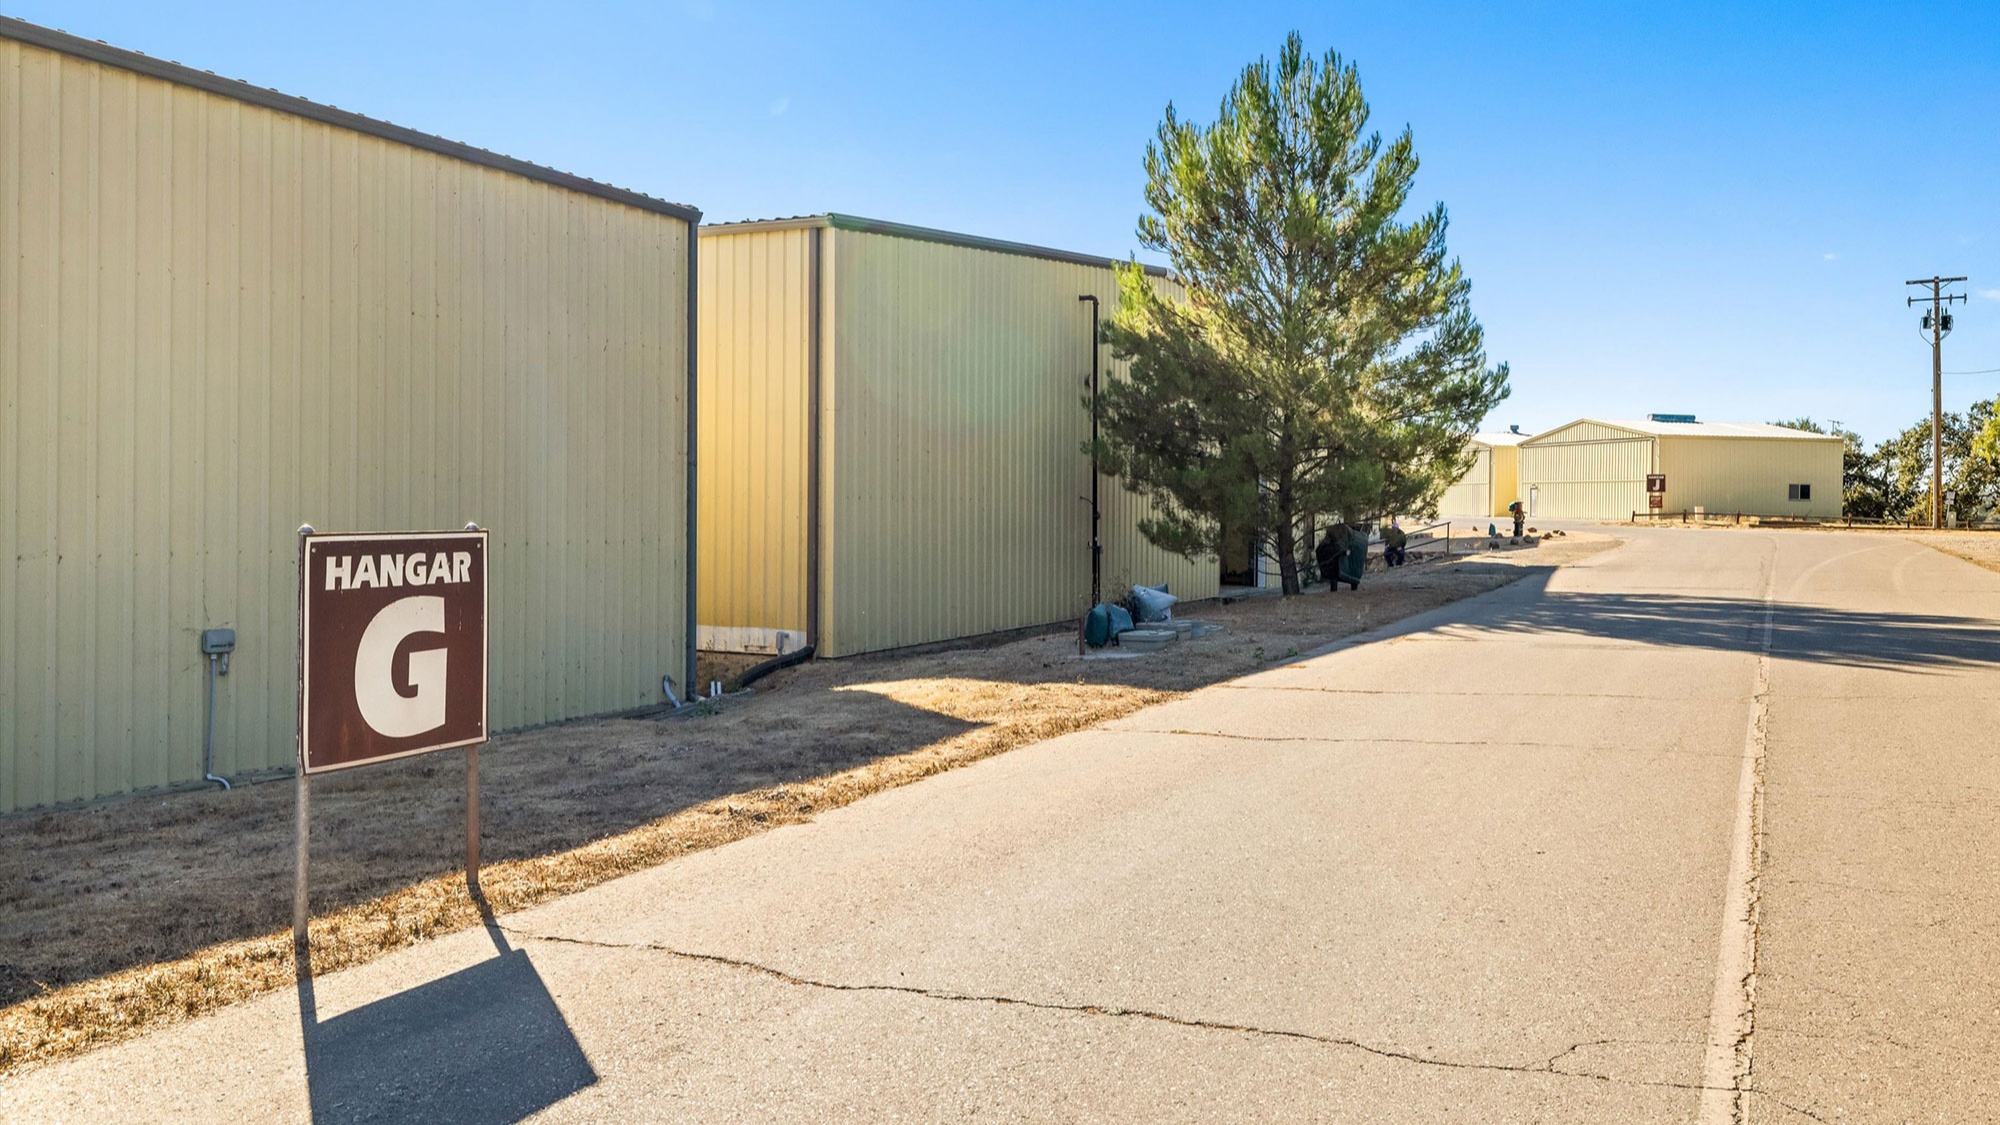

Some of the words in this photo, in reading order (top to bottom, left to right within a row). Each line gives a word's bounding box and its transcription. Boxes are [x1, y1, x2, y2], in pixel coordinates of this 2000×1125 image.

[1652, 479, 1660, 491] J
[325, 551, 472, 591] HANGAR
[354, 595, 448, 738] G
